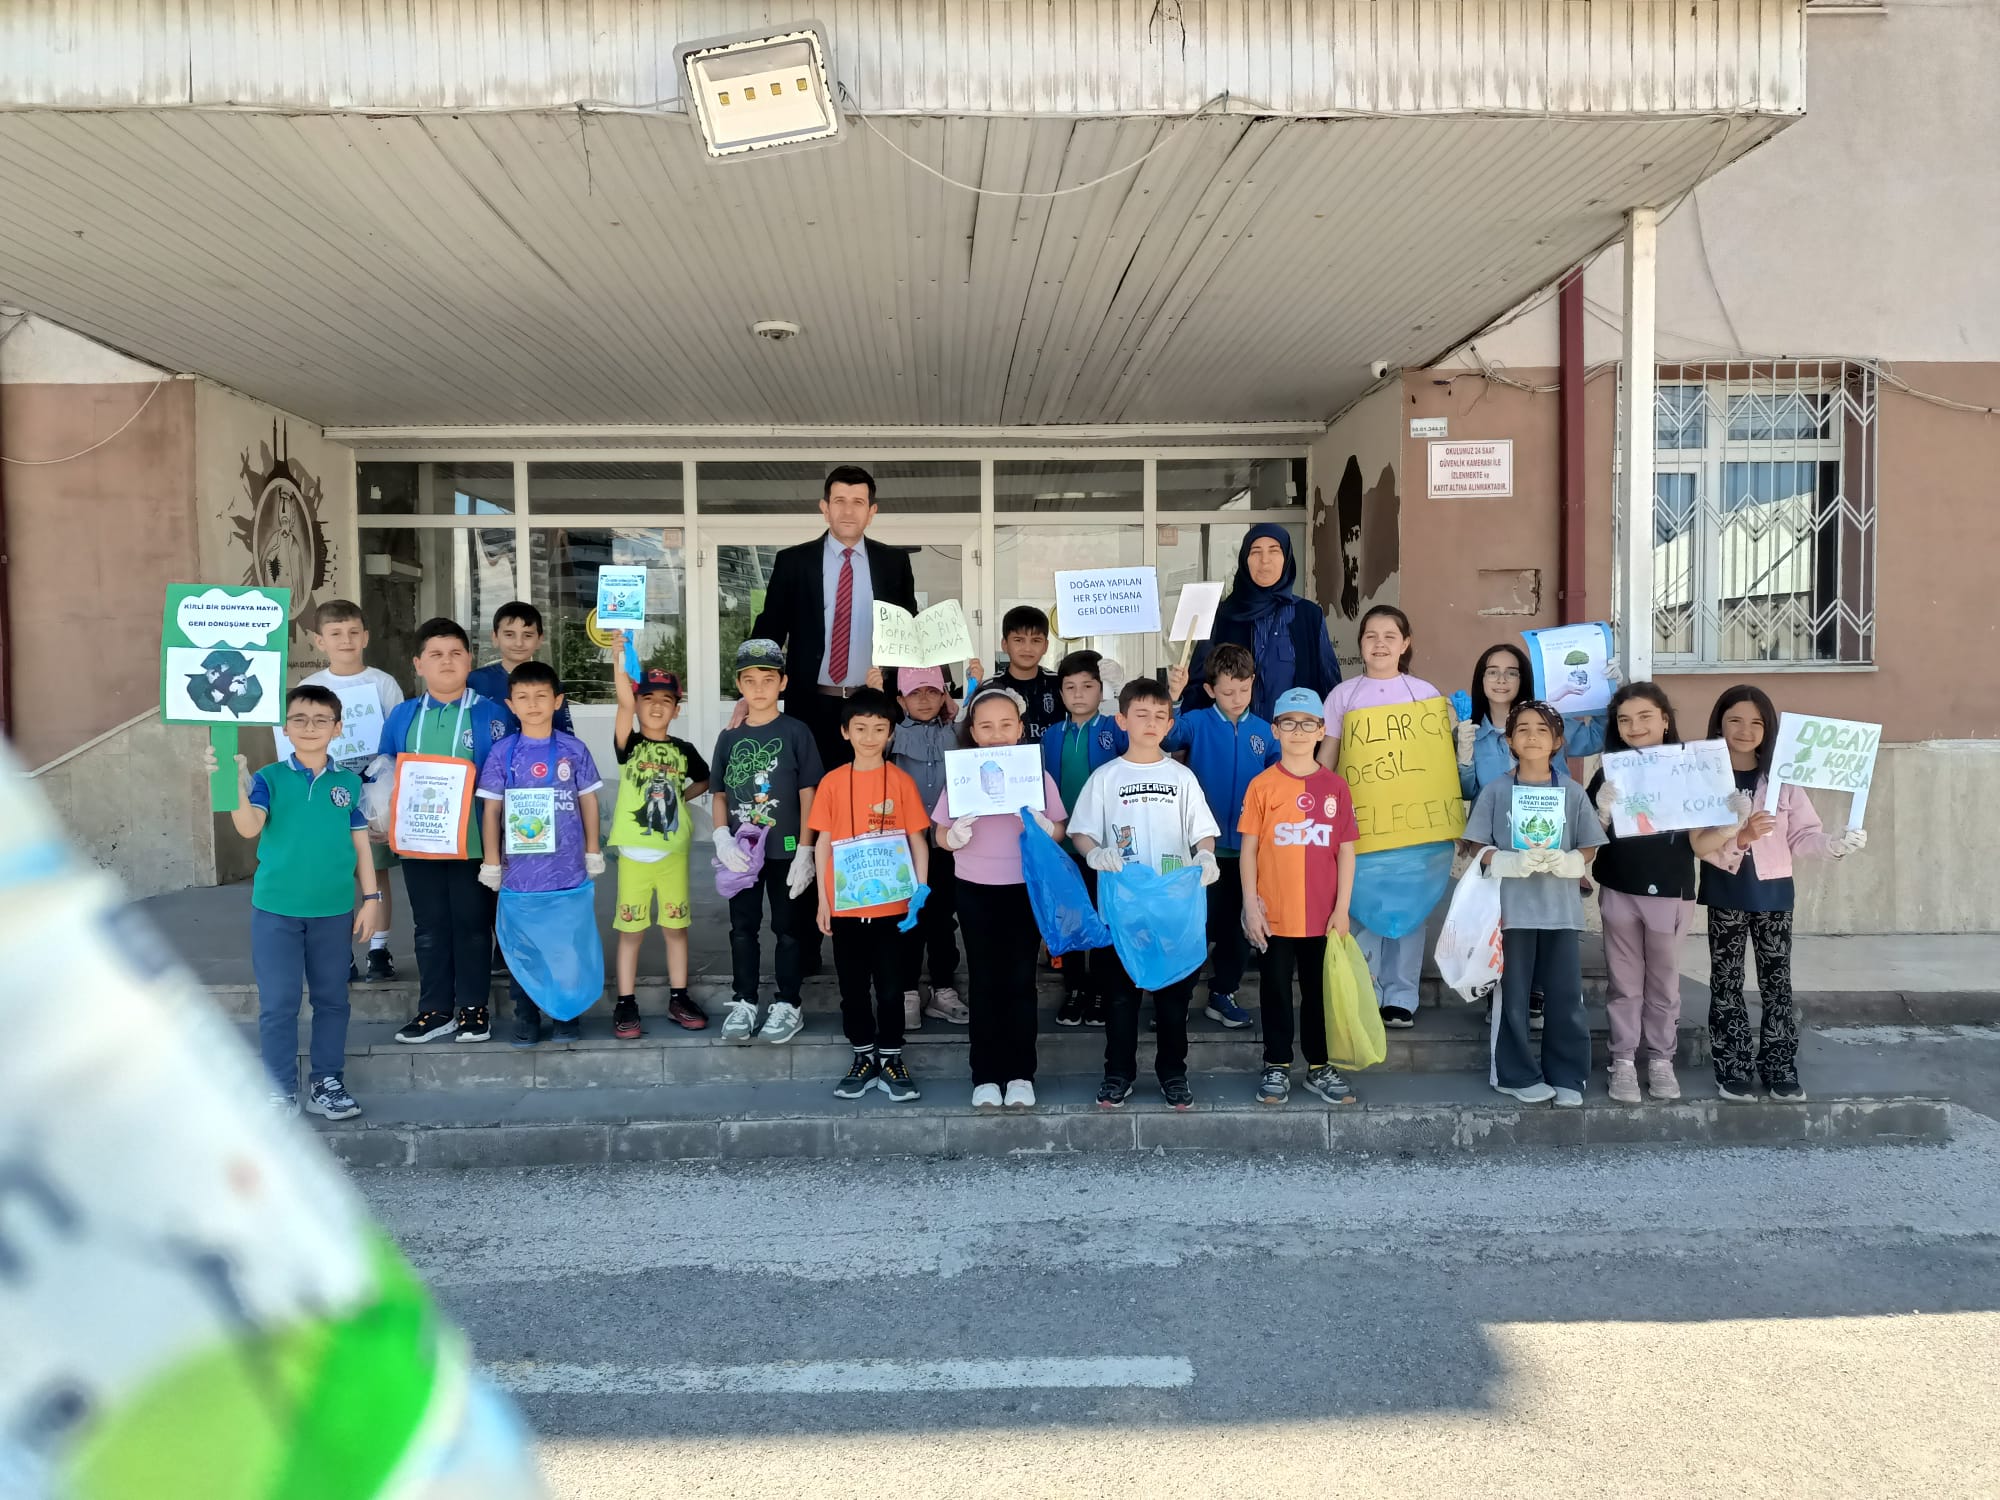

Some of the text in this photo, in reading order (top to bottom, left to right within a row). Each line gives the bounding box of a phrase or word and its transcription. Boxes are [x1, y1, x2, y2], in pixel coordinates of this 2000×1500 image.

[1446, 447, 1474, 455] OKULUMUZ
[1440, 459, 1465, 467] GÜVENLİK
[1070, 578, 1142, 590] DOĞAYA YAPILAN
[1073, 591, 1142, 602] HER ŞEY İNSANA
[1078, 606, 1098, 616] GERİ
[1796, 721, 1878, 752] DOĞAYI
[1346, 750, 1426, 786] DEĞİL
[1822, 752, 1868, 771] KORU
[511, 792, 532, 801] DOĞAYI
[1119, 783, 1177, 797] MINECRAFT
[844, 848, 894, 866] TEMİZ ÇEVRE
[852, 859, 890, 873] SAĞLIKLI
[852, 868, 891, 882] GELECEK
